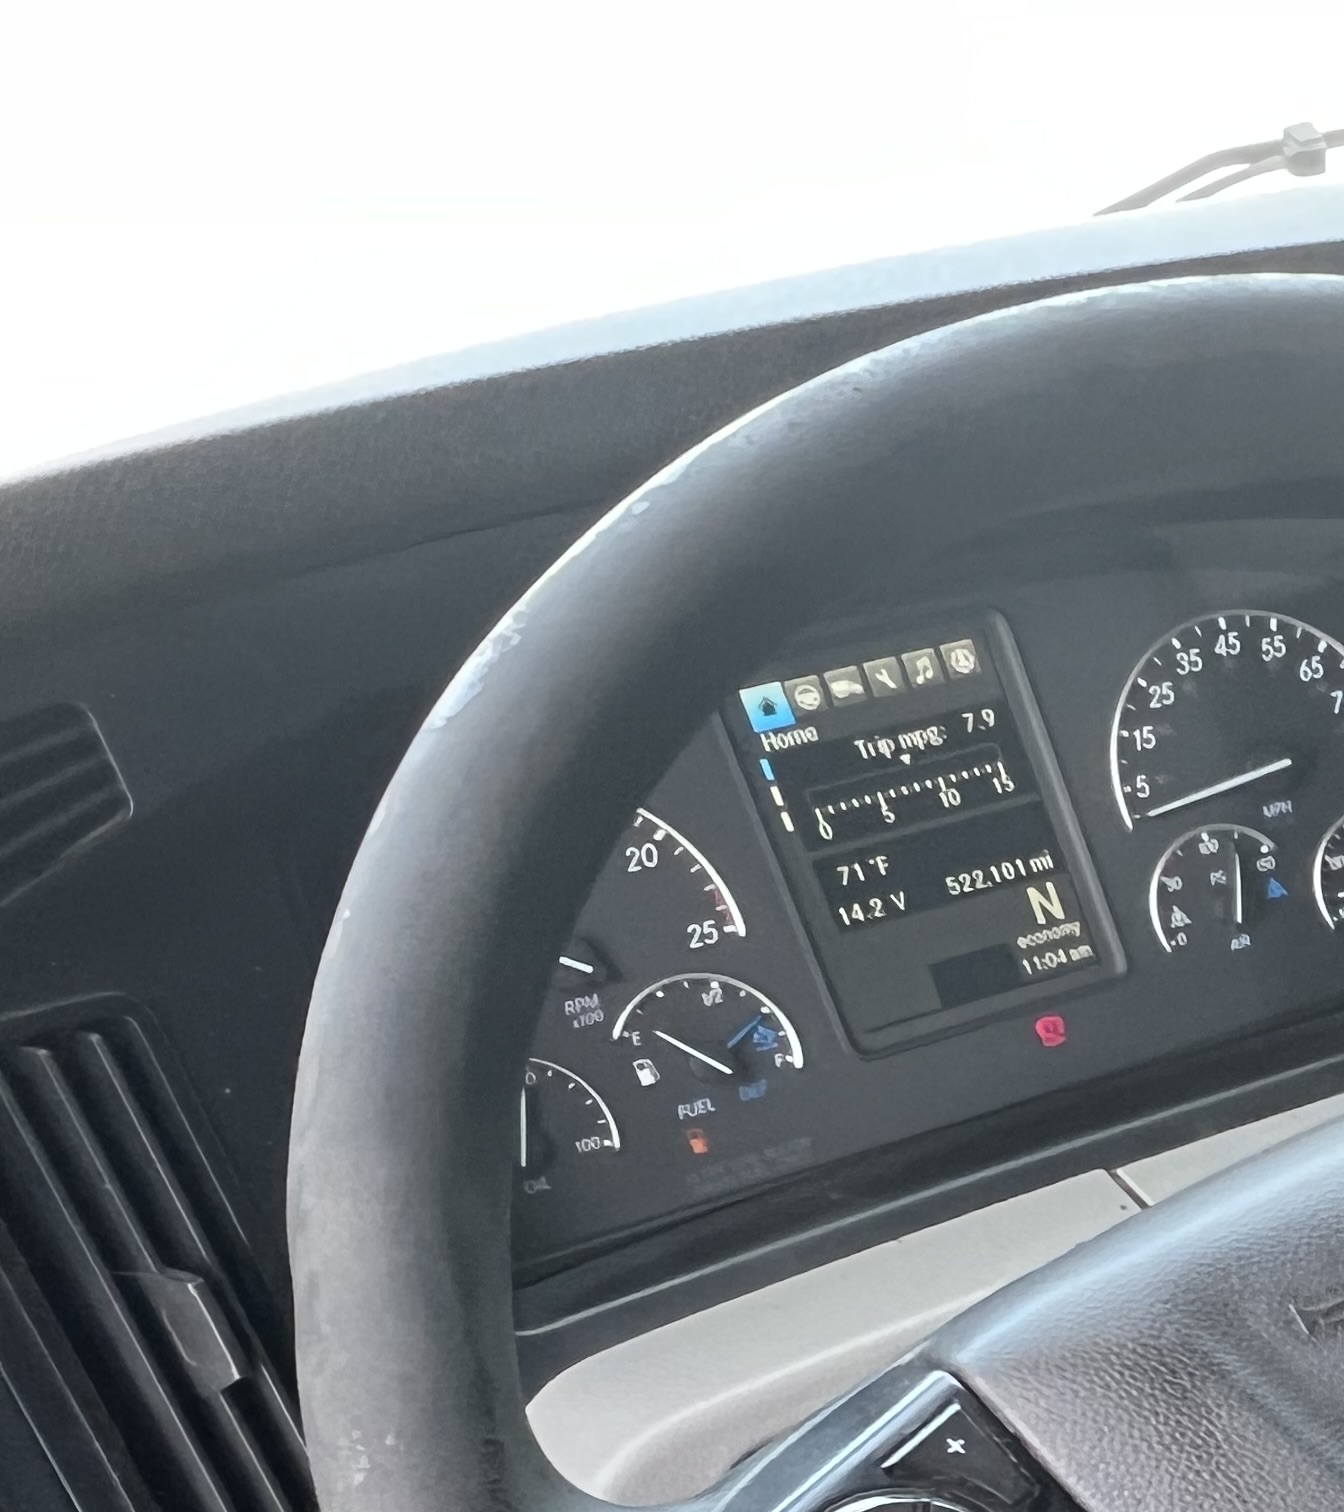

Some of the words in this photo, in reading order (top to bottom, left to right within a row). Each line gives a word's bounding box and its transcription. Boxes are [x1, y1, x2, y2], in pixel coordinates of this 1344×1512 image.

[1214, 631, 1241, 657] 45
[1261, 635, 1286, 662] 55
[1176, 648, 1203, 676] 35
[1300, 655, 1324, 682] 65
[1148, 681, 1175, 709] 25
[760, 725, 819, 753] Home
[854, 734, 895, 759] Trip
[962, 708, 995, 733] 7.9
[1132, 725, 1157, 751] 15
[1136, 775, 1150, 798] 5
[625, 842, 659, 873] 20
[1029, 849, 1054, 875] mi
[836, 862, 866, 886] 71
[838, 897, 887, 926] 14.2
[890, 890, 906, 912] V
[1026, 881, 1066, 926] N
[686, 919, 719, 949] 25
[564, 992, 600, 1017] RPM
[677, 1097, 717, 1121] FUEL
